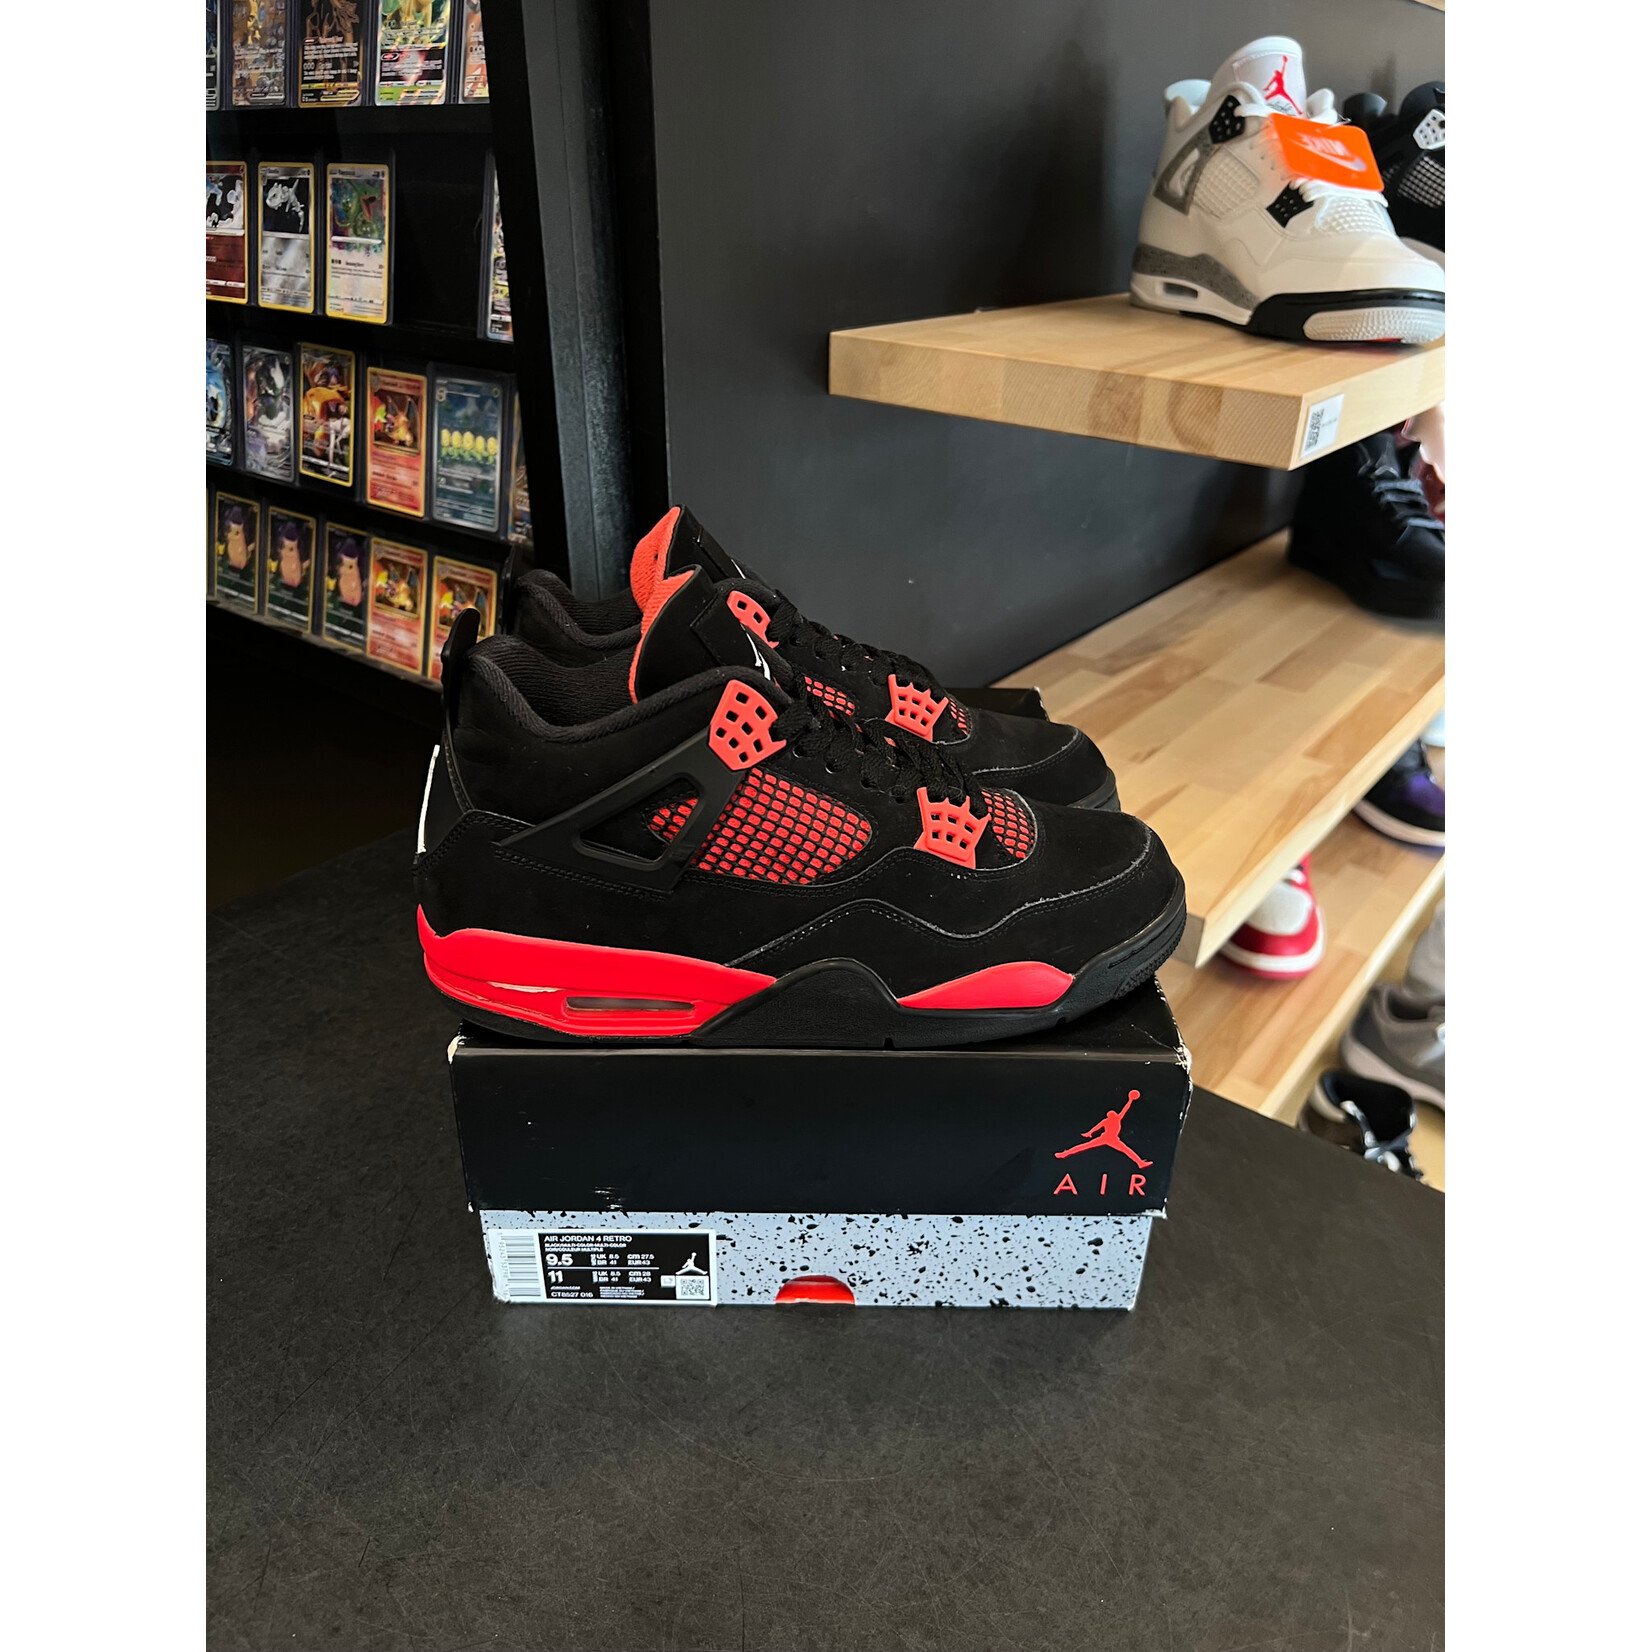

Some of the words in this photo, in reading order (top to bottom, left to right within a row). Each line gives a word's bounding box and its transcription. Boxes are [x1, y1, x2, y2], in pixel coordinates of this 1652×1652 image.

[1053, 1173, 1147, 1196] AIR
[545, 1253, 574, 1266] 9.5
[547, 1270, 564, 1283] 11
